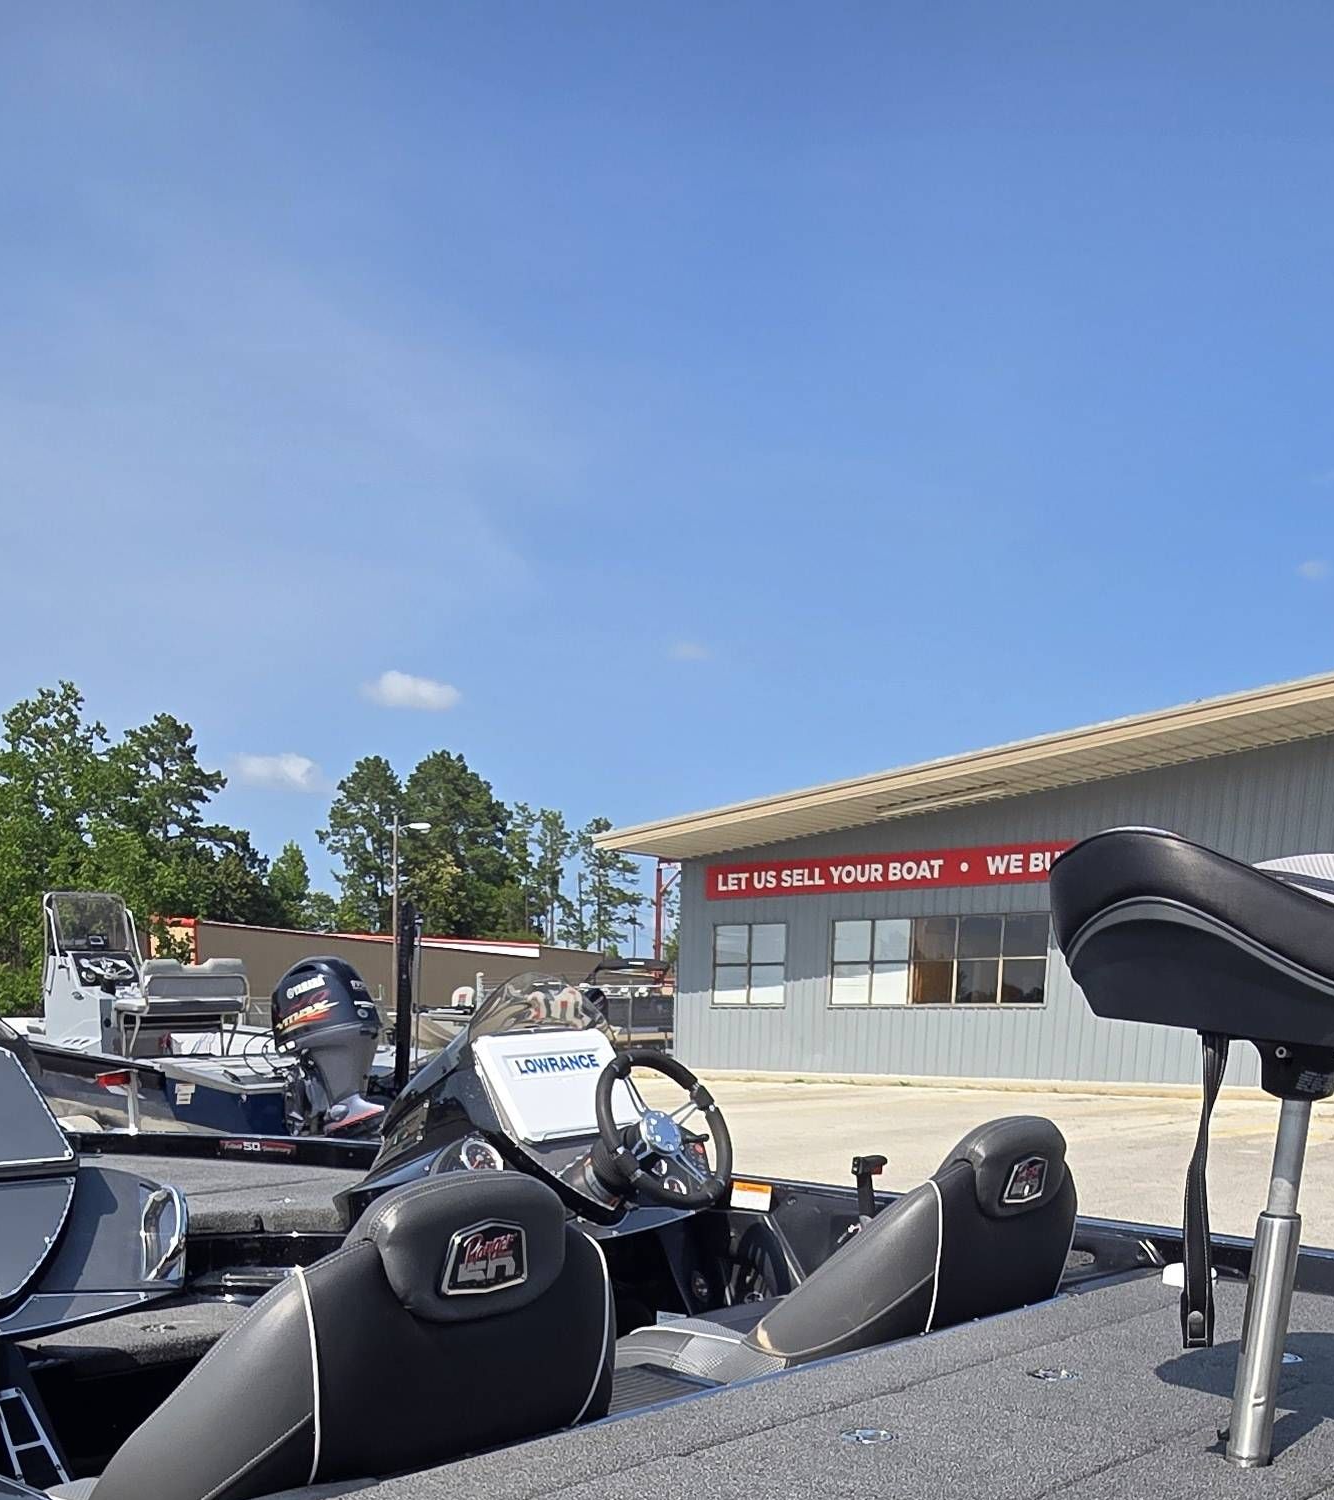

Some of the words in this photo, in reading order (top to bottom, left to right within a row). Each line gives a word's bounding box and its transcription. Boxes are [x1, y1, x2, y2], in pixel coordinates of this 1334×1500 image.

[717, 872, 749, 892] LET
[753, 870, 777, 890] US
[780, 867, 825, 887] SELL
[829, 863, 883, 885] YOUR
[887, 859, 944, 881] BOAT
[986, 854, 1023, 875] WE
[1028, 850, 1065, 873] BU
[514, 1053, 600, 1076] LOWRANCE
